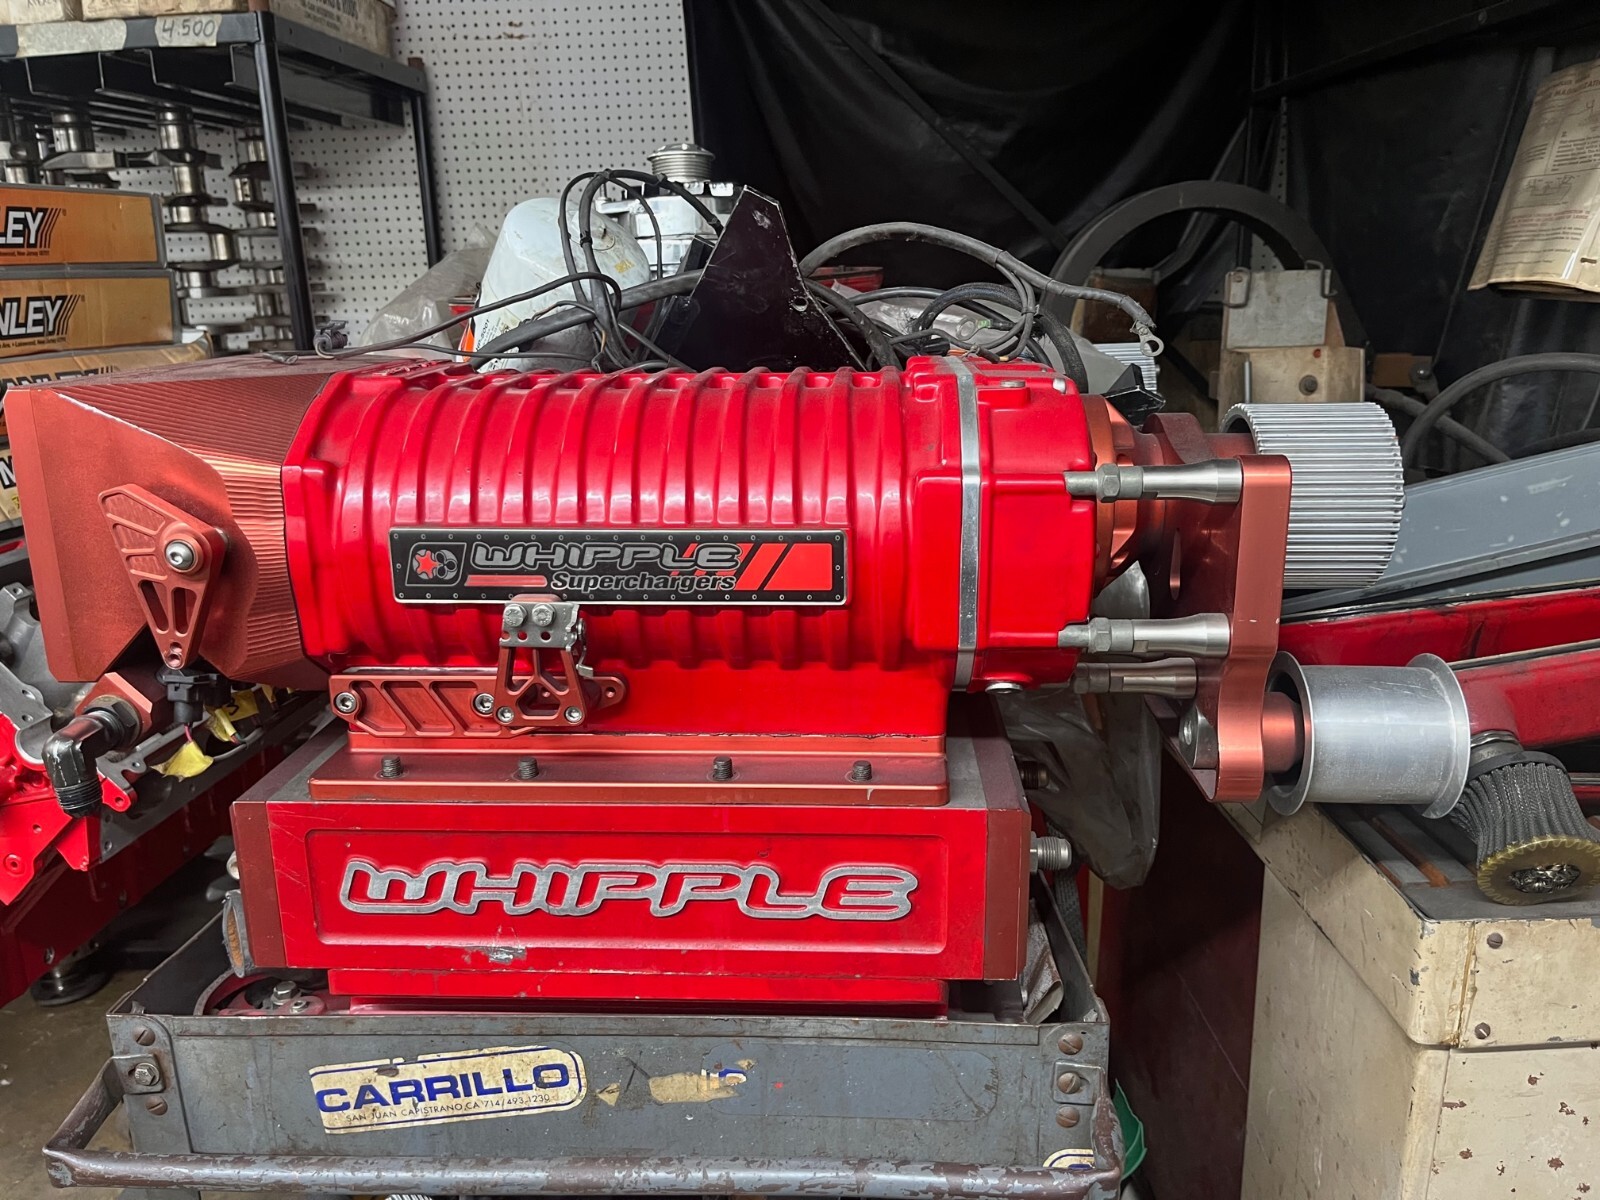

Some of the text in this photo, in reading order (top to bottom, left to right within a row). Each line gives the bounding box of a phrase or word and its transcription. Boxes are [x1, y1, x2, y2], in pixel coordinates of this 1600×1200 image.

[161, 18, 216, 38] 4.500
[470, 541, 744, 571] WHIPPLE
[551, 571, 737, 593] Superchargers
[339, 859, 920, 922] WHIPPLE
[316, 1062, 571, 1114] CARRILLO
[345, 1113, 367, 1123] SAN
[372, 1109, 397, 1120] JUAN
